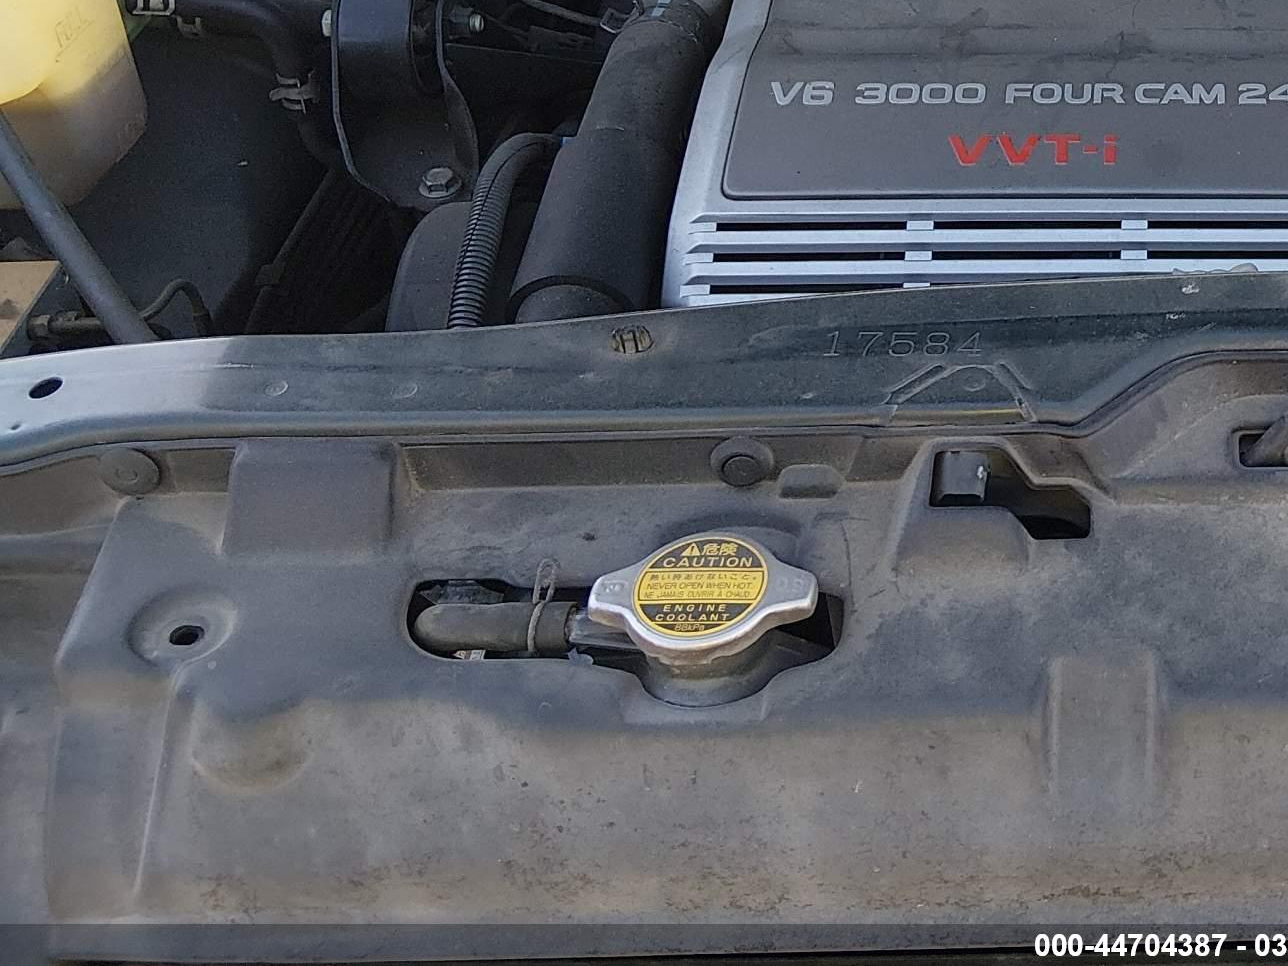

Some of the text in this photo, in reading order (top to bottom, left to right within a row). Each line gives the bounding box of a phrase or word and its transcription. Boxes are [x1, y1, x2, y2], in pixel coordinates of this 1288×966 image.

[769, 81, 835, 106] V6
[855, 81, 986, 106] 3000
[1004, 82, 1126, 105] FOUR
[1134, 82, 1226, 105] CAM
[948, 135, 1118, 166] VVT-i
[822, 330, 983, 357] 17584
[701, 543, 738, 556] 危険
[663, 556, 753, 568] CAUTION
[647, 582, 677, 590] NEVER
[679, 582, 705, 590] OPEN
[705, 582, 731, 590] WHEN
[662, 604, 728, 612] ENGINE
[655, 613, 730, 622] COOLANT
